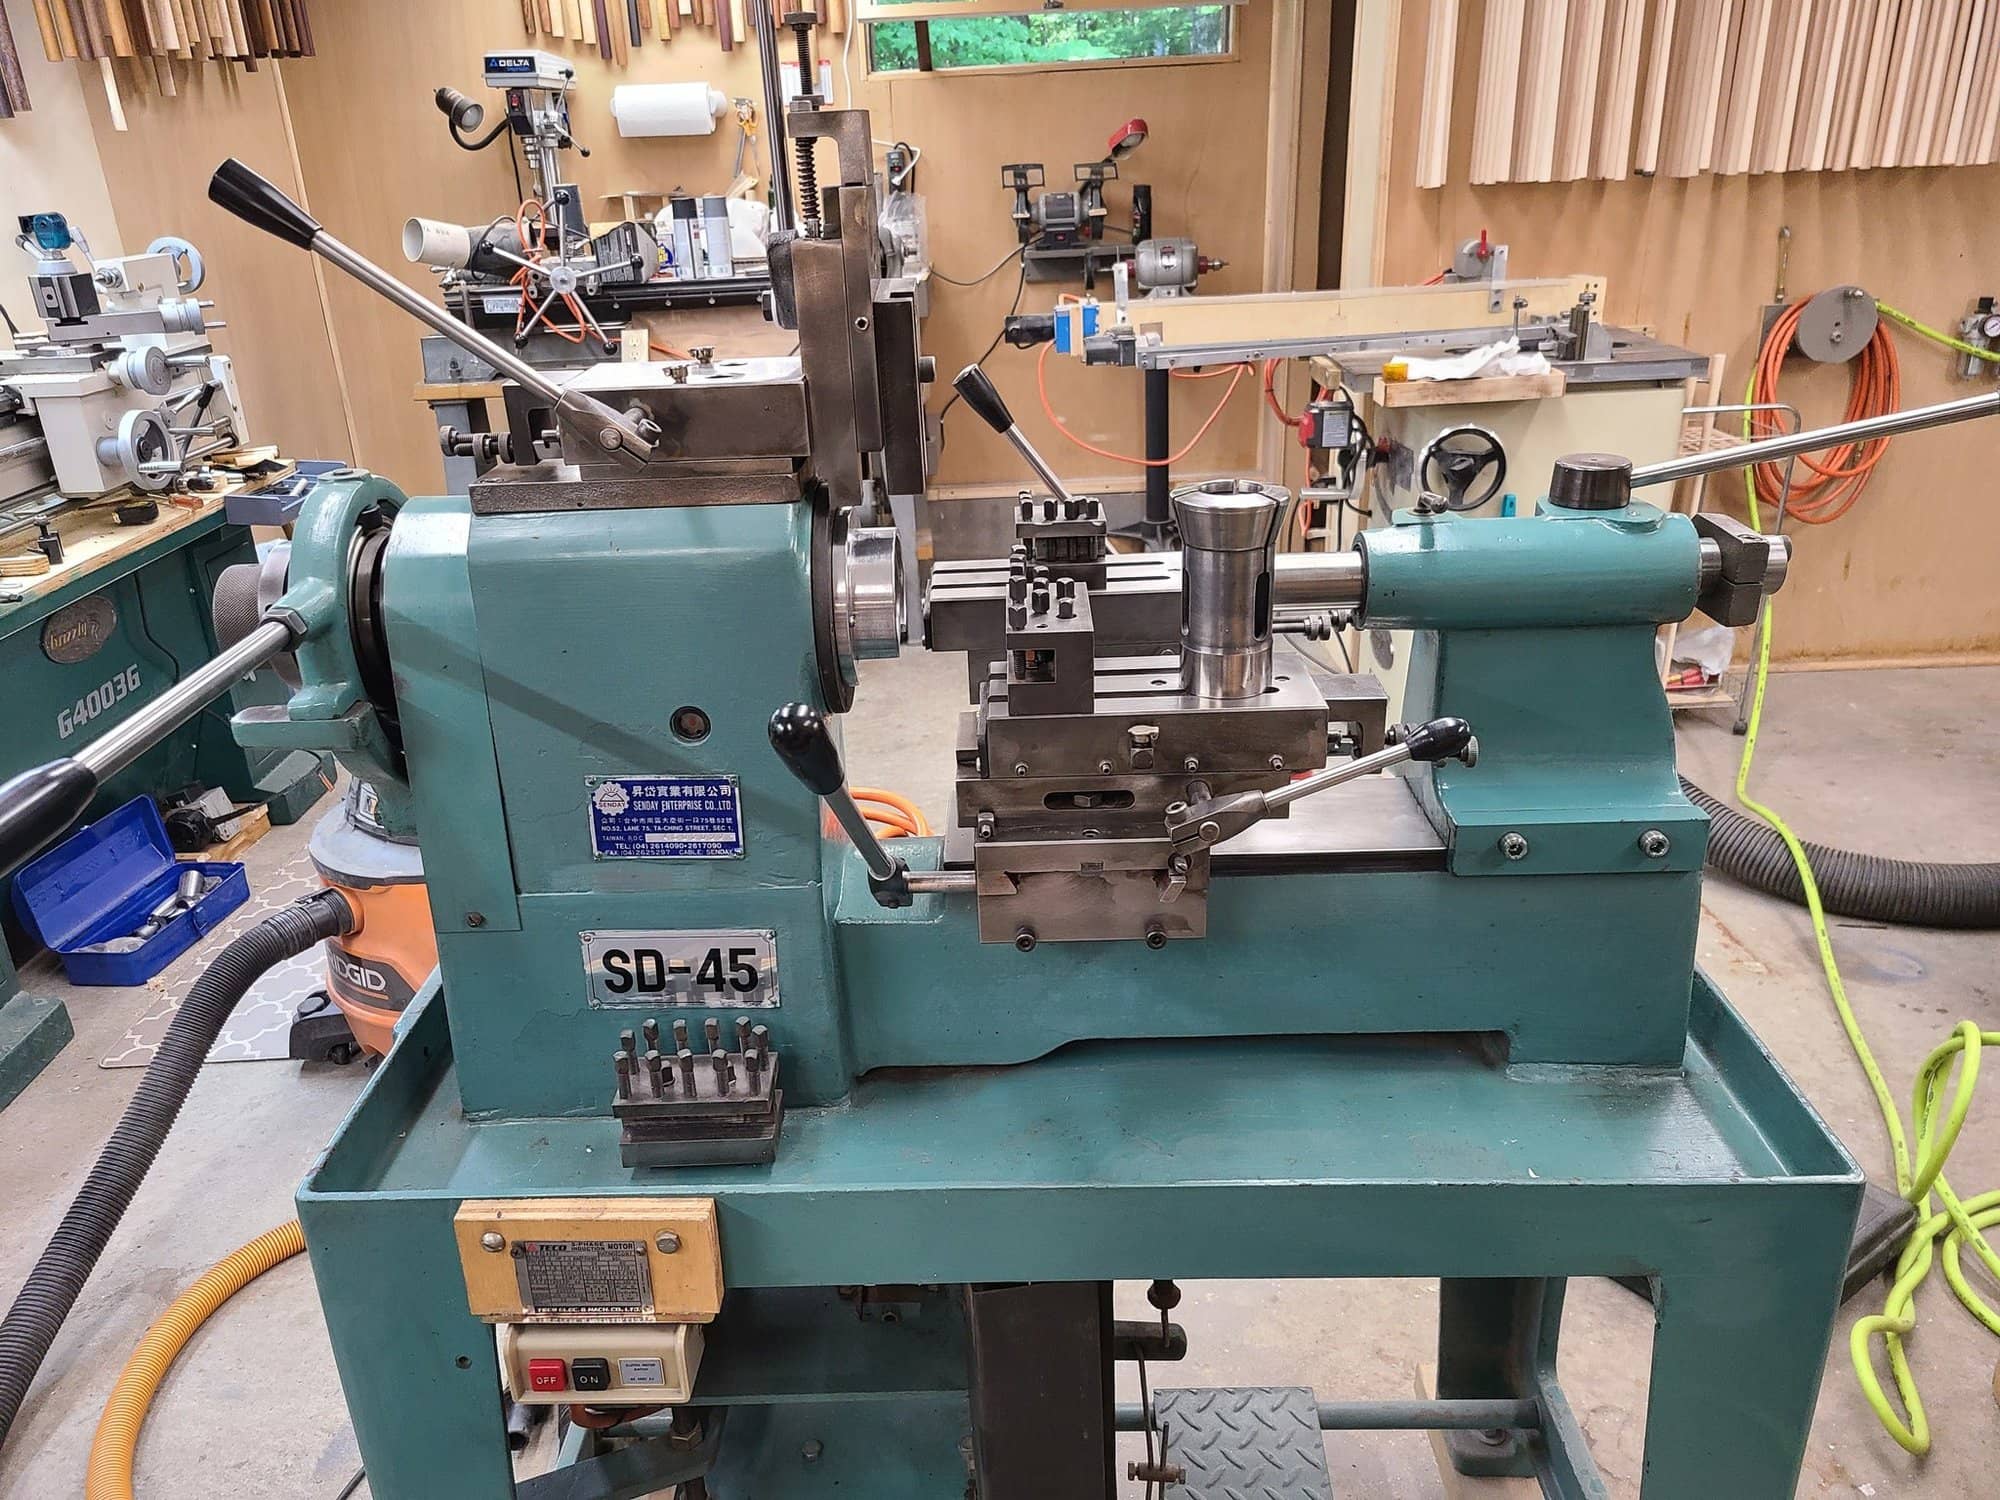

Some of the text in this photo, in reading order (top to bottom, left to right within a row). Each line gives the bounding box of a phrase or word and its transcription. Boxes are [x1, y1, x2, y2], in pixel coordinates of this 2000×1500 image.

[498, 59, 530, 67] DELTA
[57, 663, 142, 740] G4003G
[633, 801, 659, 811] SENDAY
[661, 800, 703, 811] ENTERPRISE
[602, 947, 759, 994] SD-45
[540, 1244, 567, 1252] TECO
[536, 1376, 557, 1385] OFF
[579, 1375, 599, 1385] ON
